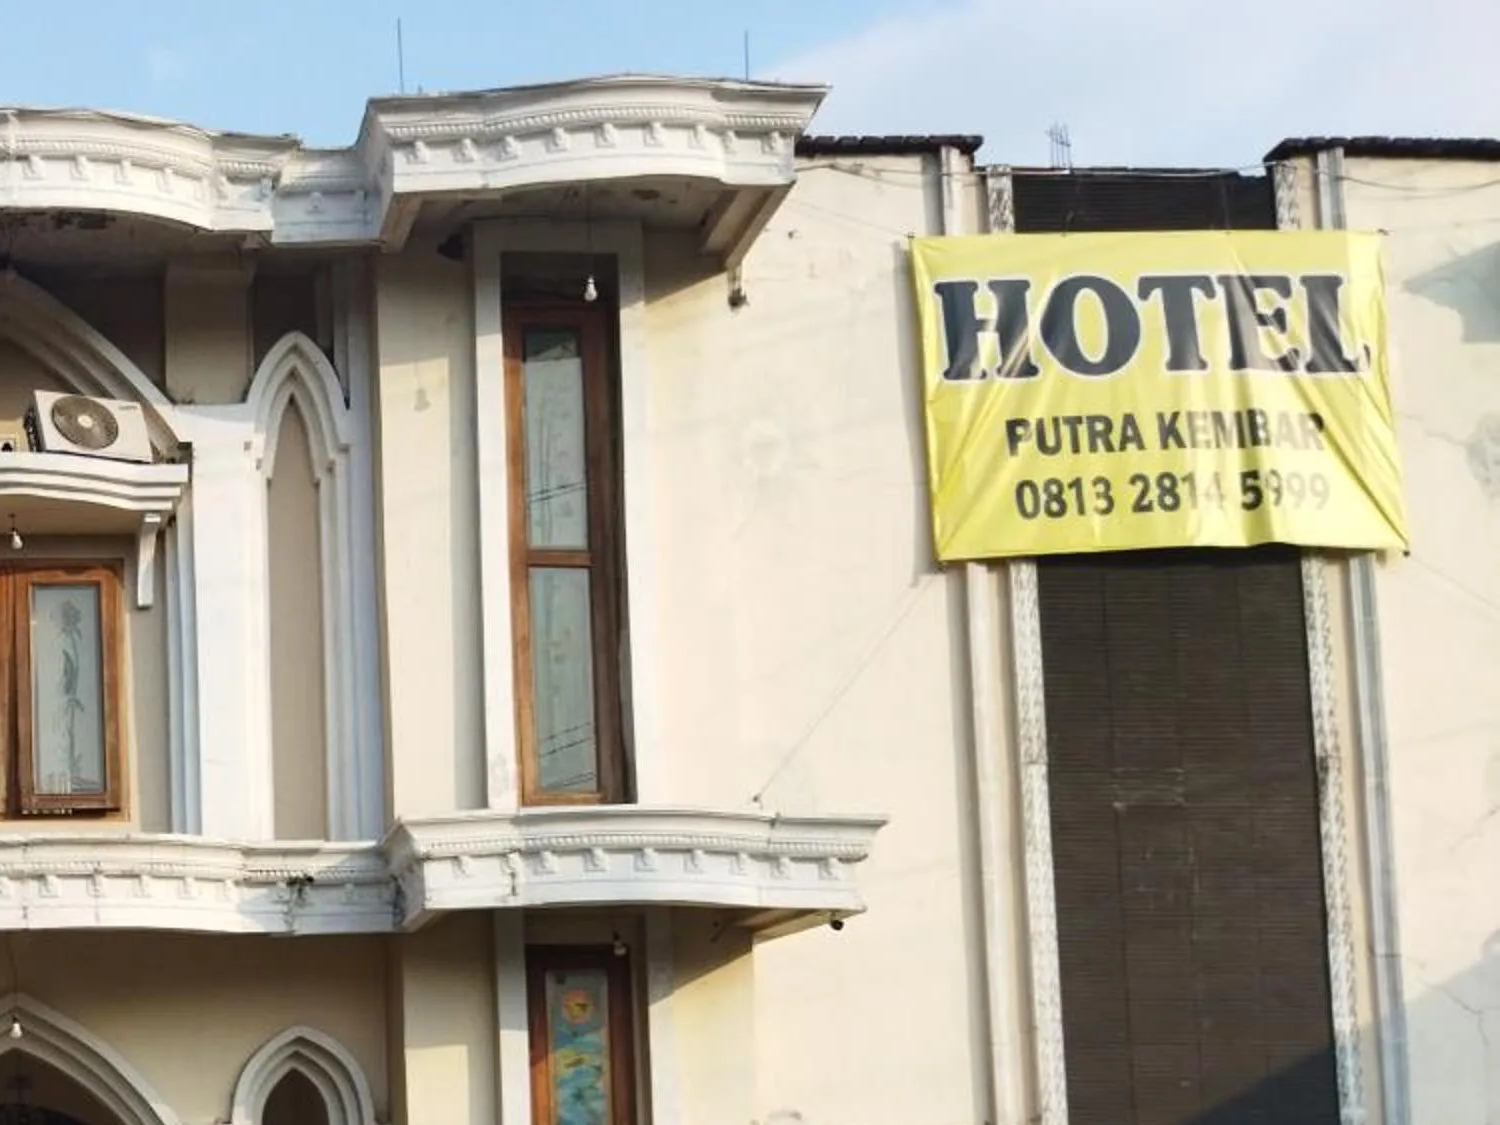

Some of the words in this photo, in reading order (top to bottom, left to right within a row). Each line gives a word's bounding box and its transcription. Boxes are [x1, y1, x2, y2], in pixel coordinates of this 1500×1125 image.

[933, 274, 1371, 381] HOTEL
[1005, 412, 1147, 457] PUTRA
[1156, 408, 1325, 451] KEMBAR
[1014, 476, 1115, 520] 0813
[1128, 471, 1226, 513] 2814
[1240, 469, 1330, 512] 5999
